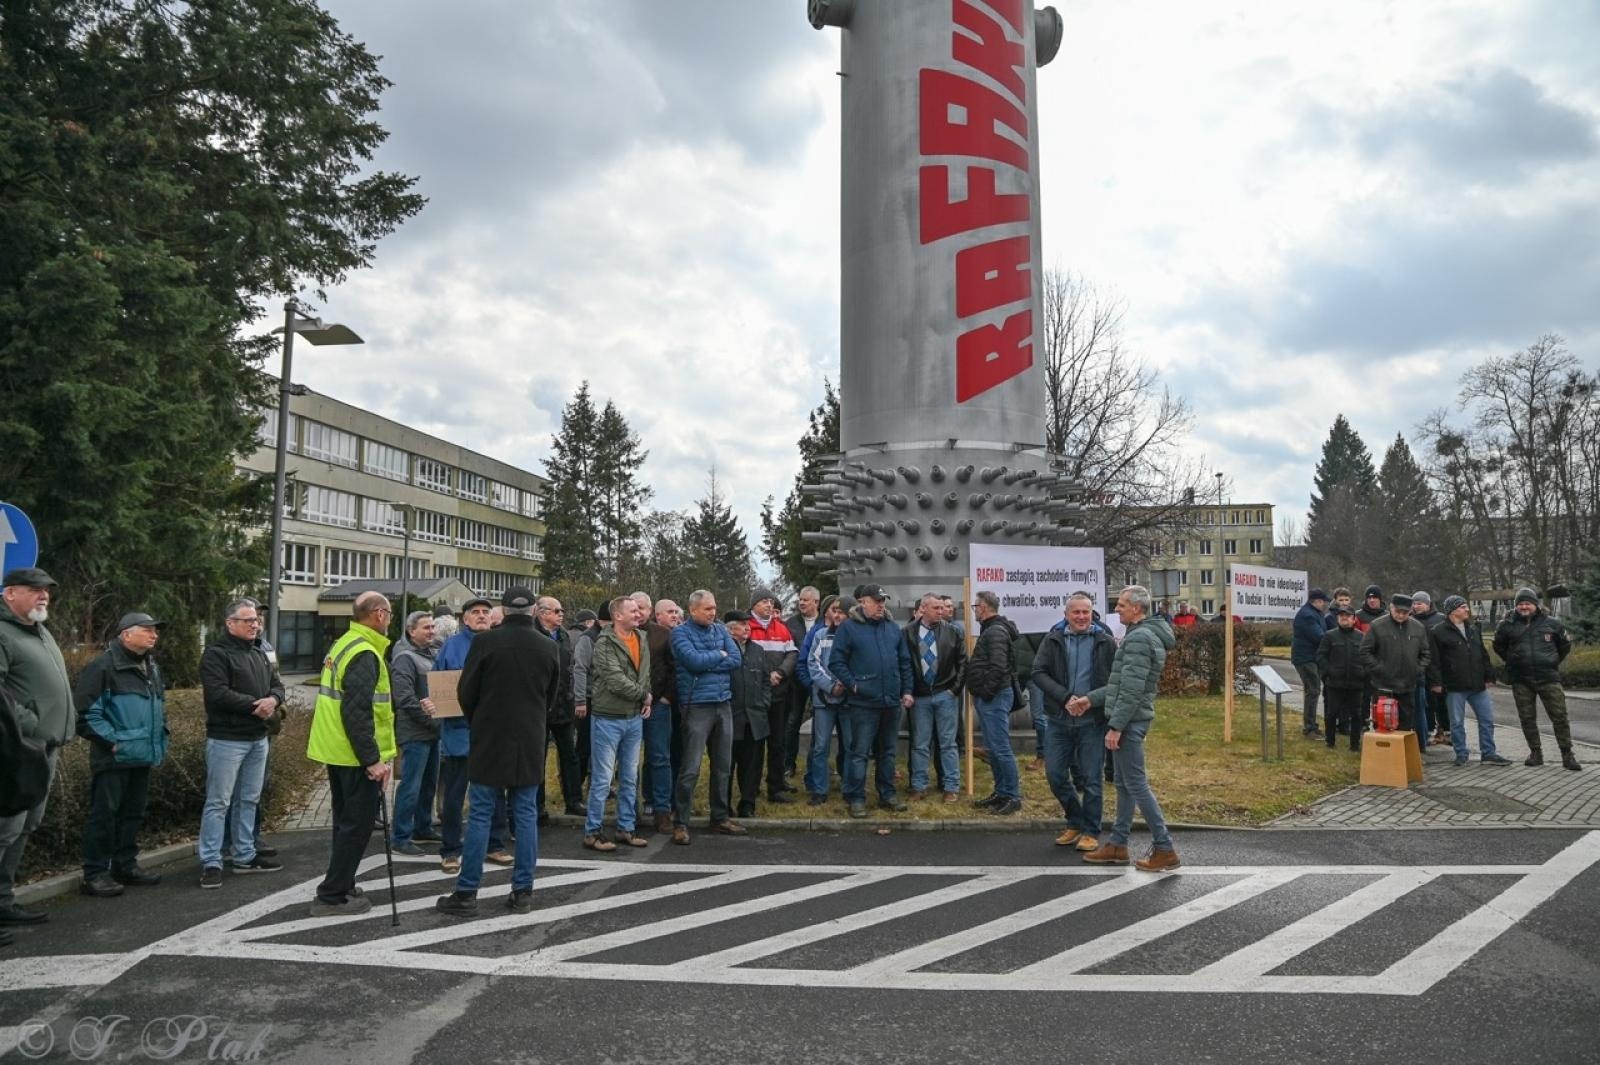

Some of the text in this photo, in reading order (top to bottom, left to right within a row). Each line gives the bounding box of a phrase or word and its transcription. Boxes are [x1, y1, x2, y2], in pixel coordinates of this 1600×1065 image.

[976, 567, 1005, 583] RAFAKO
[1006, 569, 1035, 585] zastąpią
[1036, 569, 1070, 583] zachodnie
[1040, 595, 1061, 609] swego
